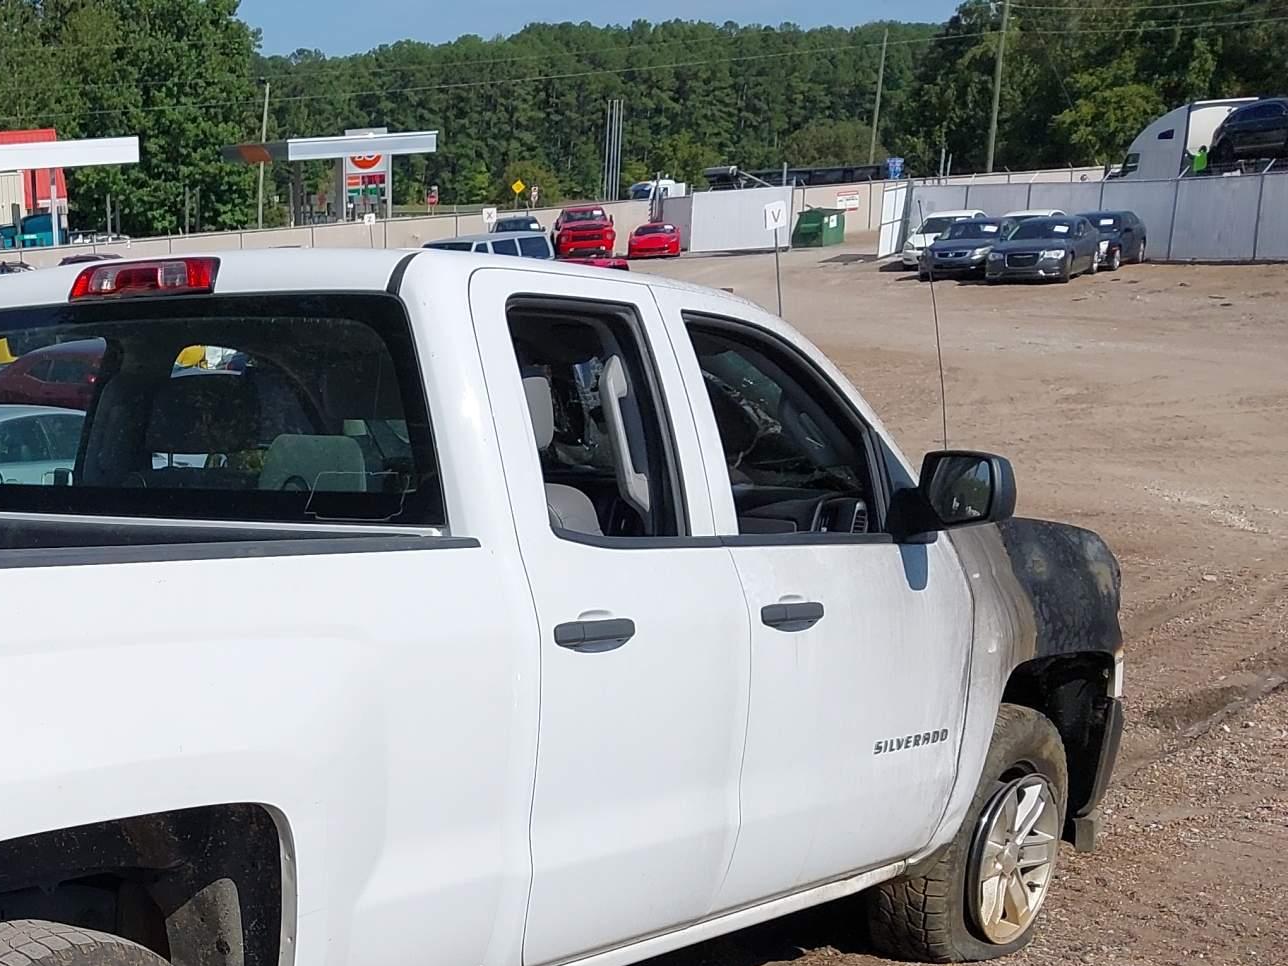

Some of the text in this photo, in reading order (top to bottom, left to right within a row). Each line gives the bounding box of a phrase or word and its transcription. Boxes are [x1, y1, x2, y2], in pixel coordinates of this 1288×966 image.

[486, 211, 493, 221] X
[771, 208, 781, 223] V
[873, 730, 949, 755] SILVERADO
